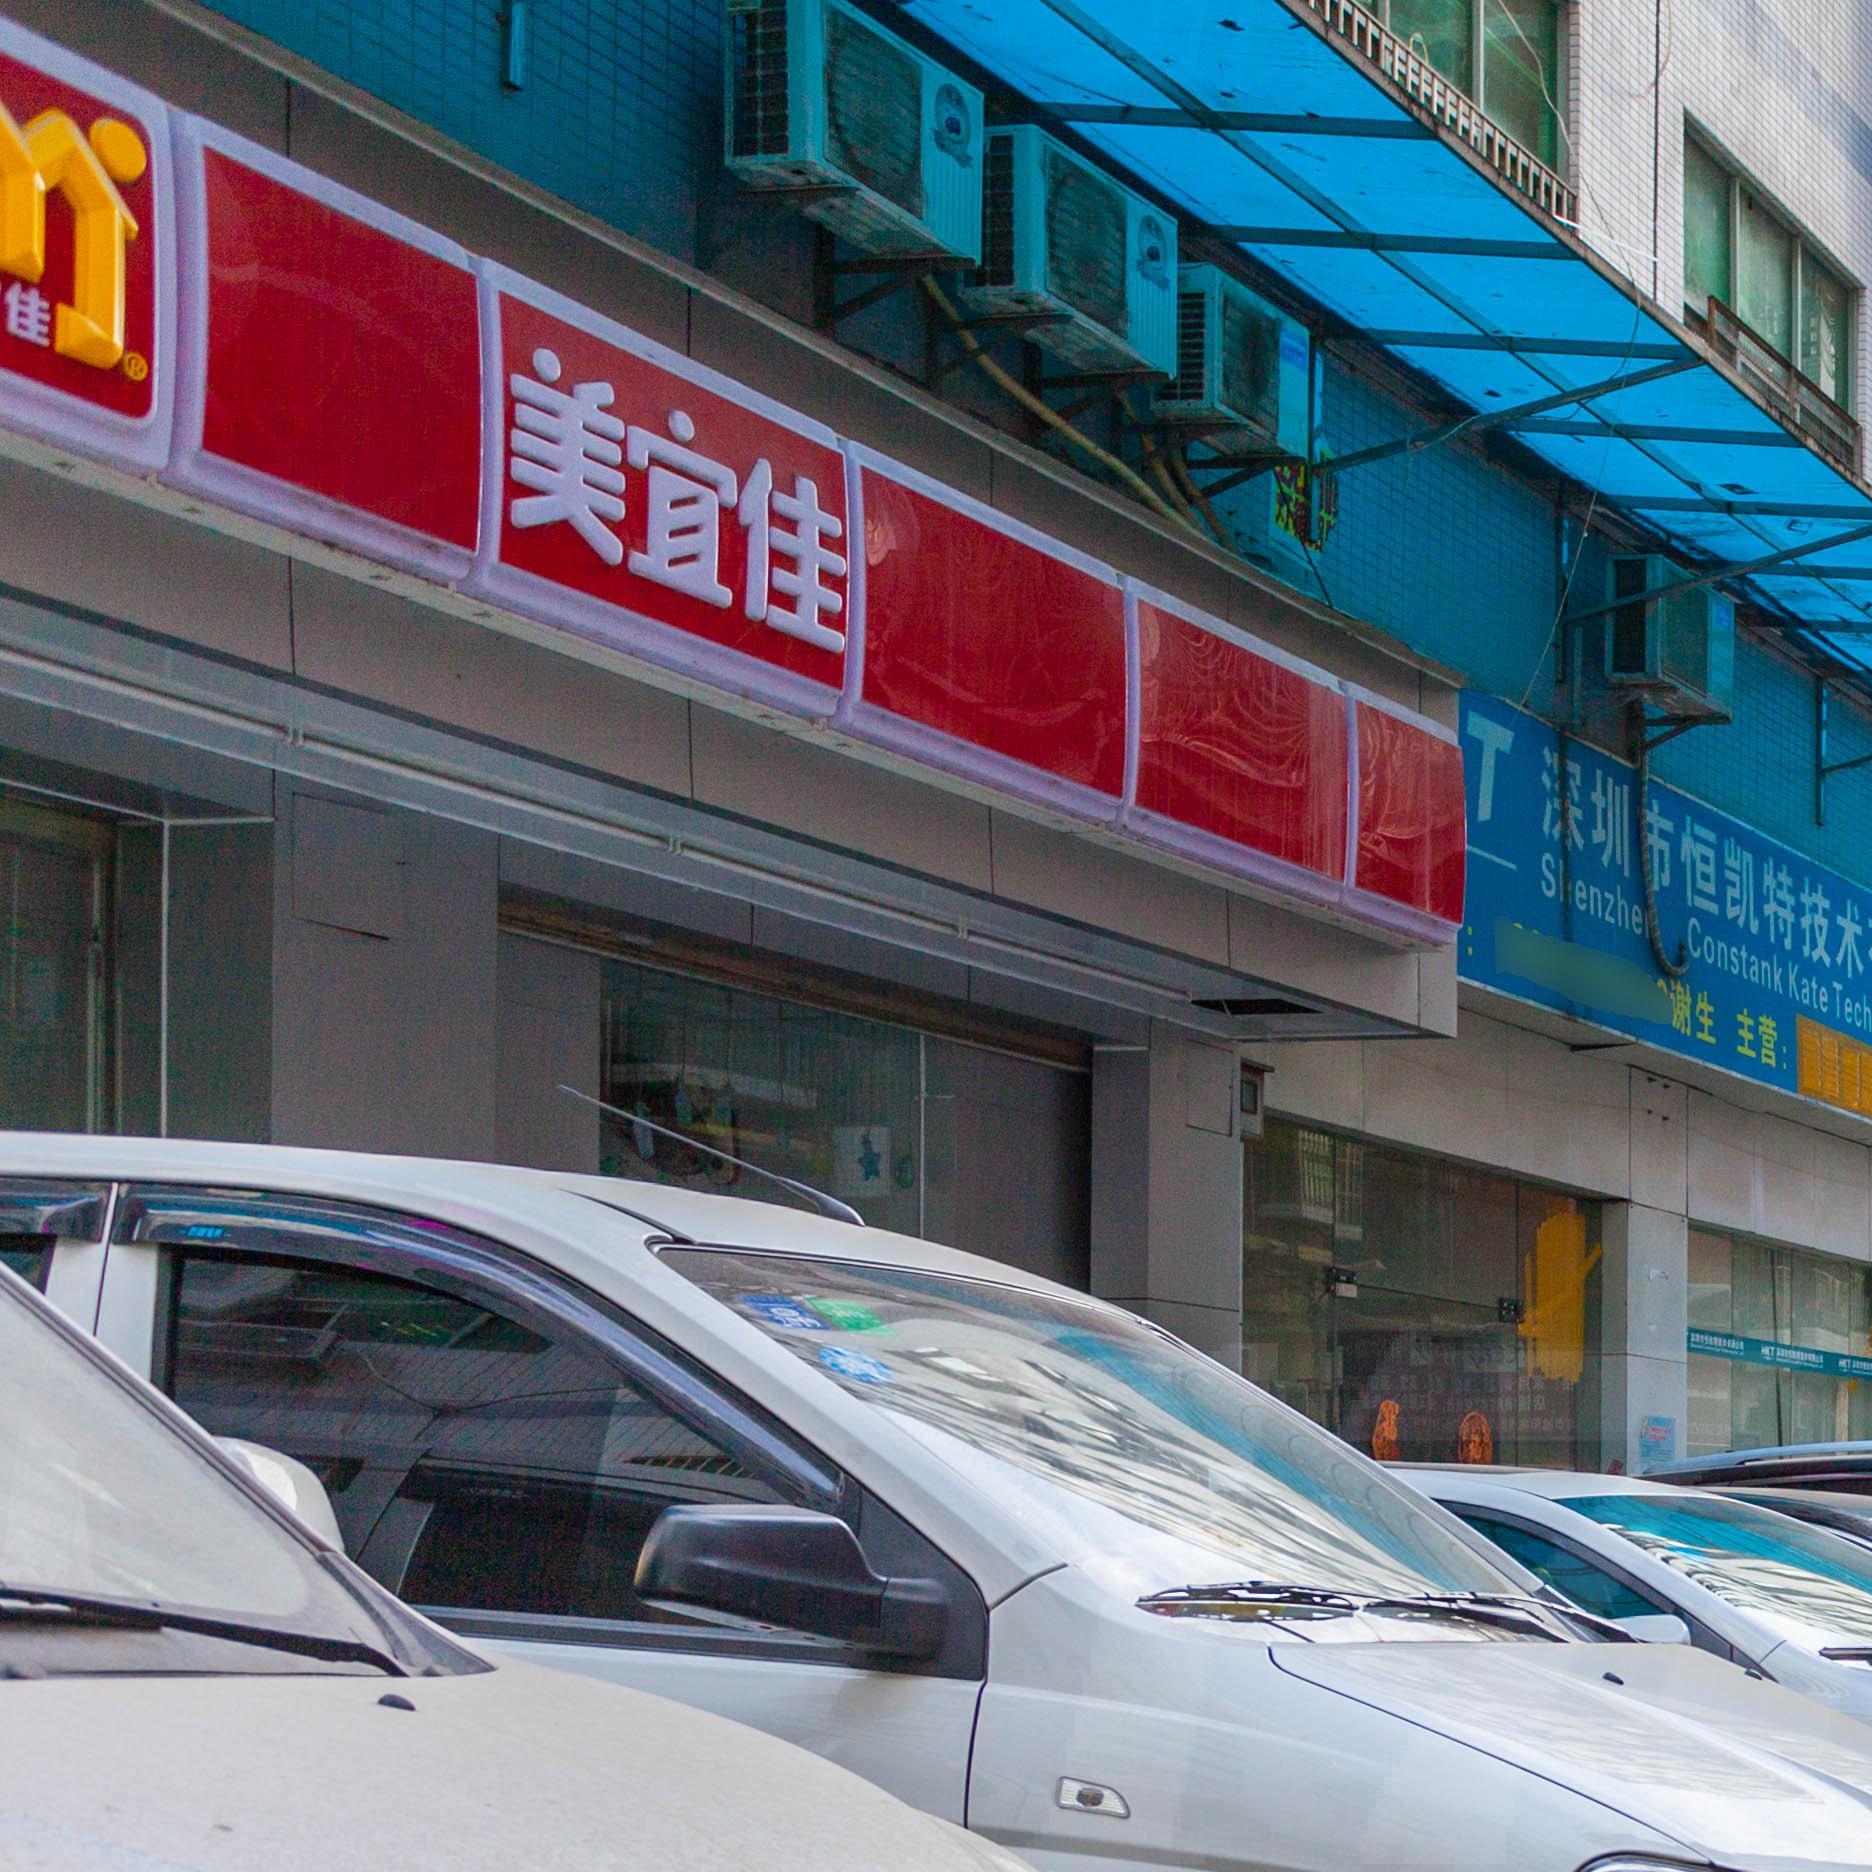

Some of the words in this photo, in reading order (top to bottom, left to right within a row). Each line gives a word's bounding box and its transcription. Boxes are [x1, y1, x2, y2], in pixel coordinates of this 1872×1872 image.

[510, 347, 847, 653] 美宜佳
[1687, 917, 1784, 995] Constank
[1788, 960, 1829, 1014] Kate
